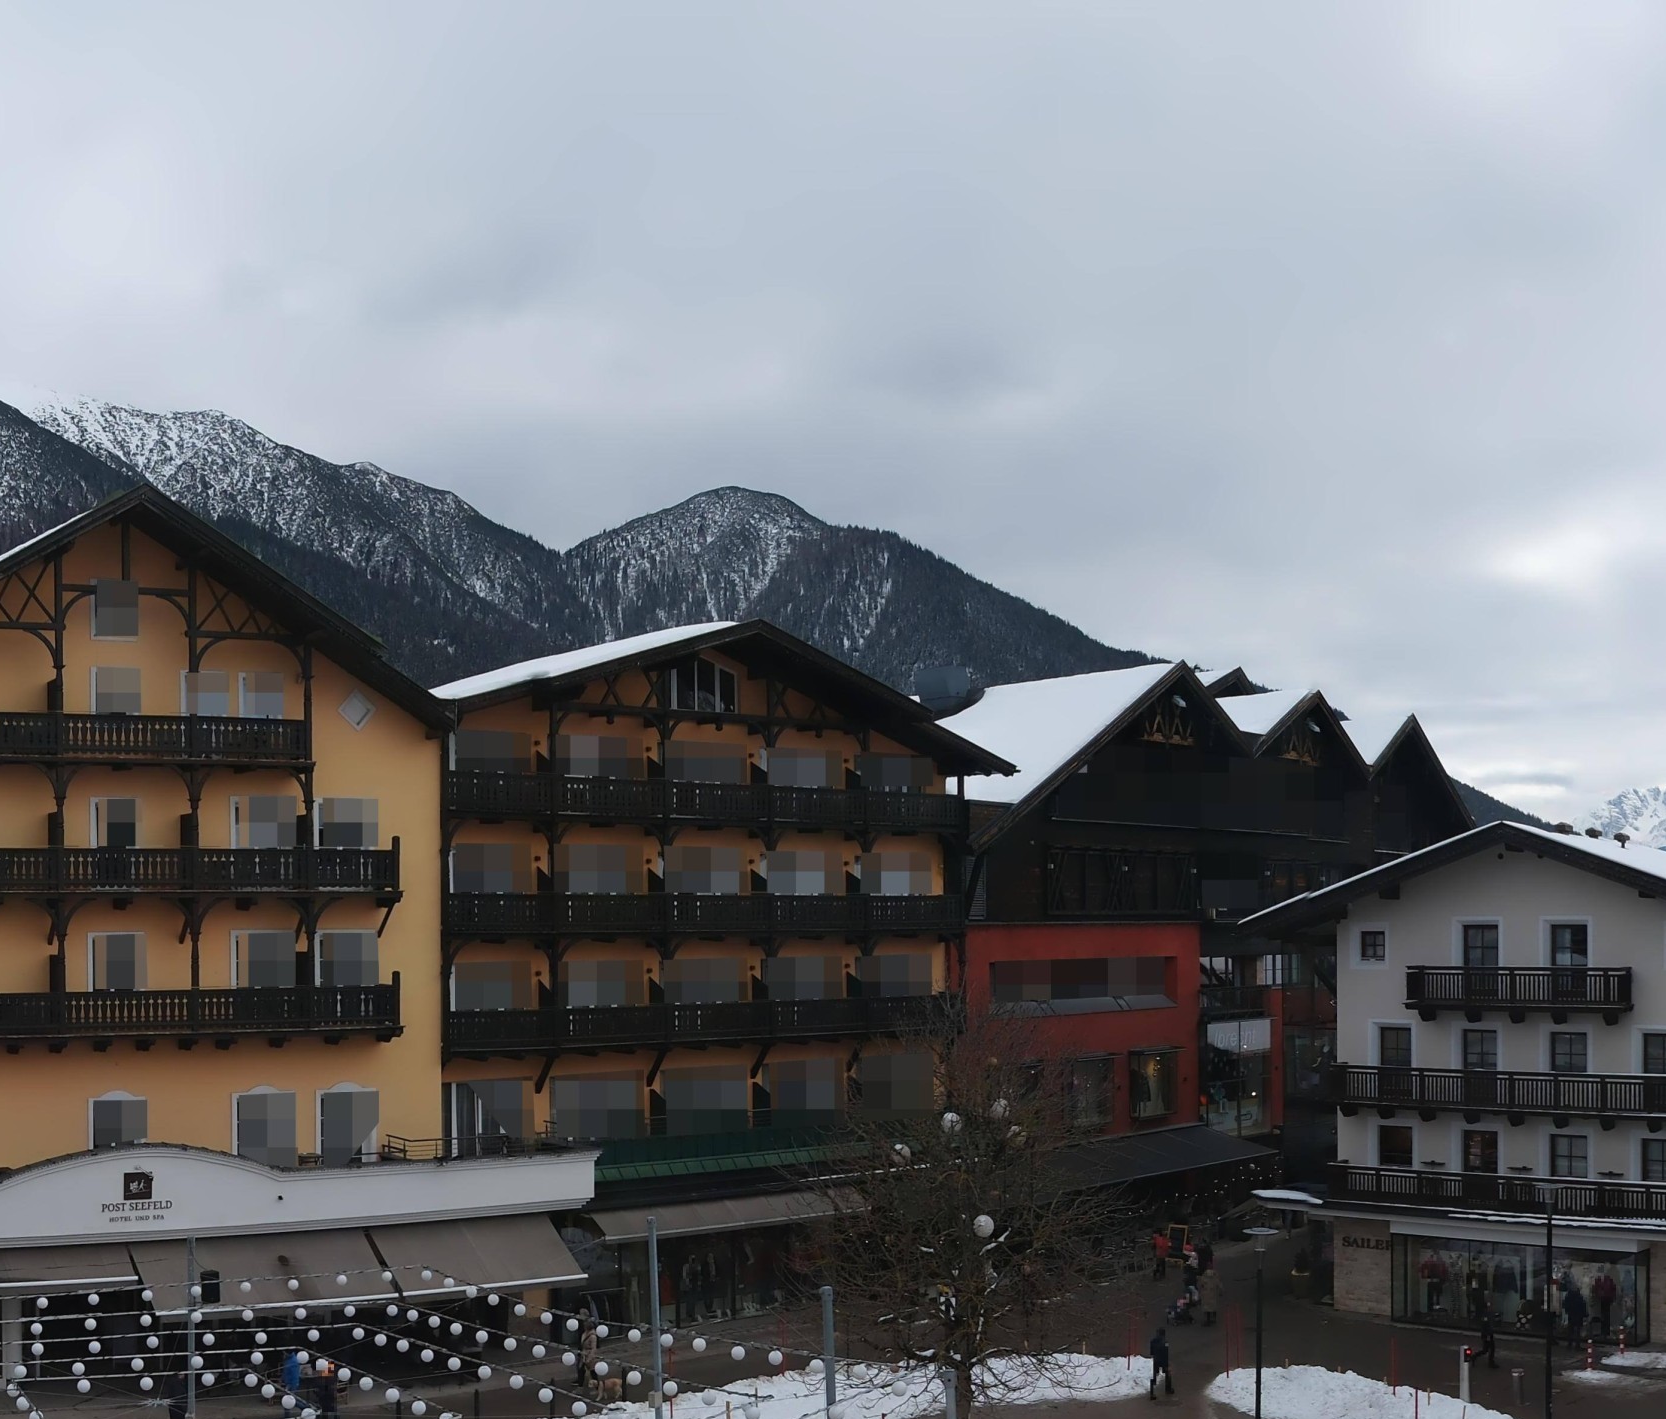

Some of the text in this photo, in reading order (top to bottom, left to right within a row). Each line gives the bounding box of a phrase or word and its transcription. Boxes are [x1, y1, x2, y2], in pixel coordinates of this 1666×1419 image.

[101, 1200, 173, 1213] POST SEEFELD
[109, 1215, 133, 1223] HOTEL
